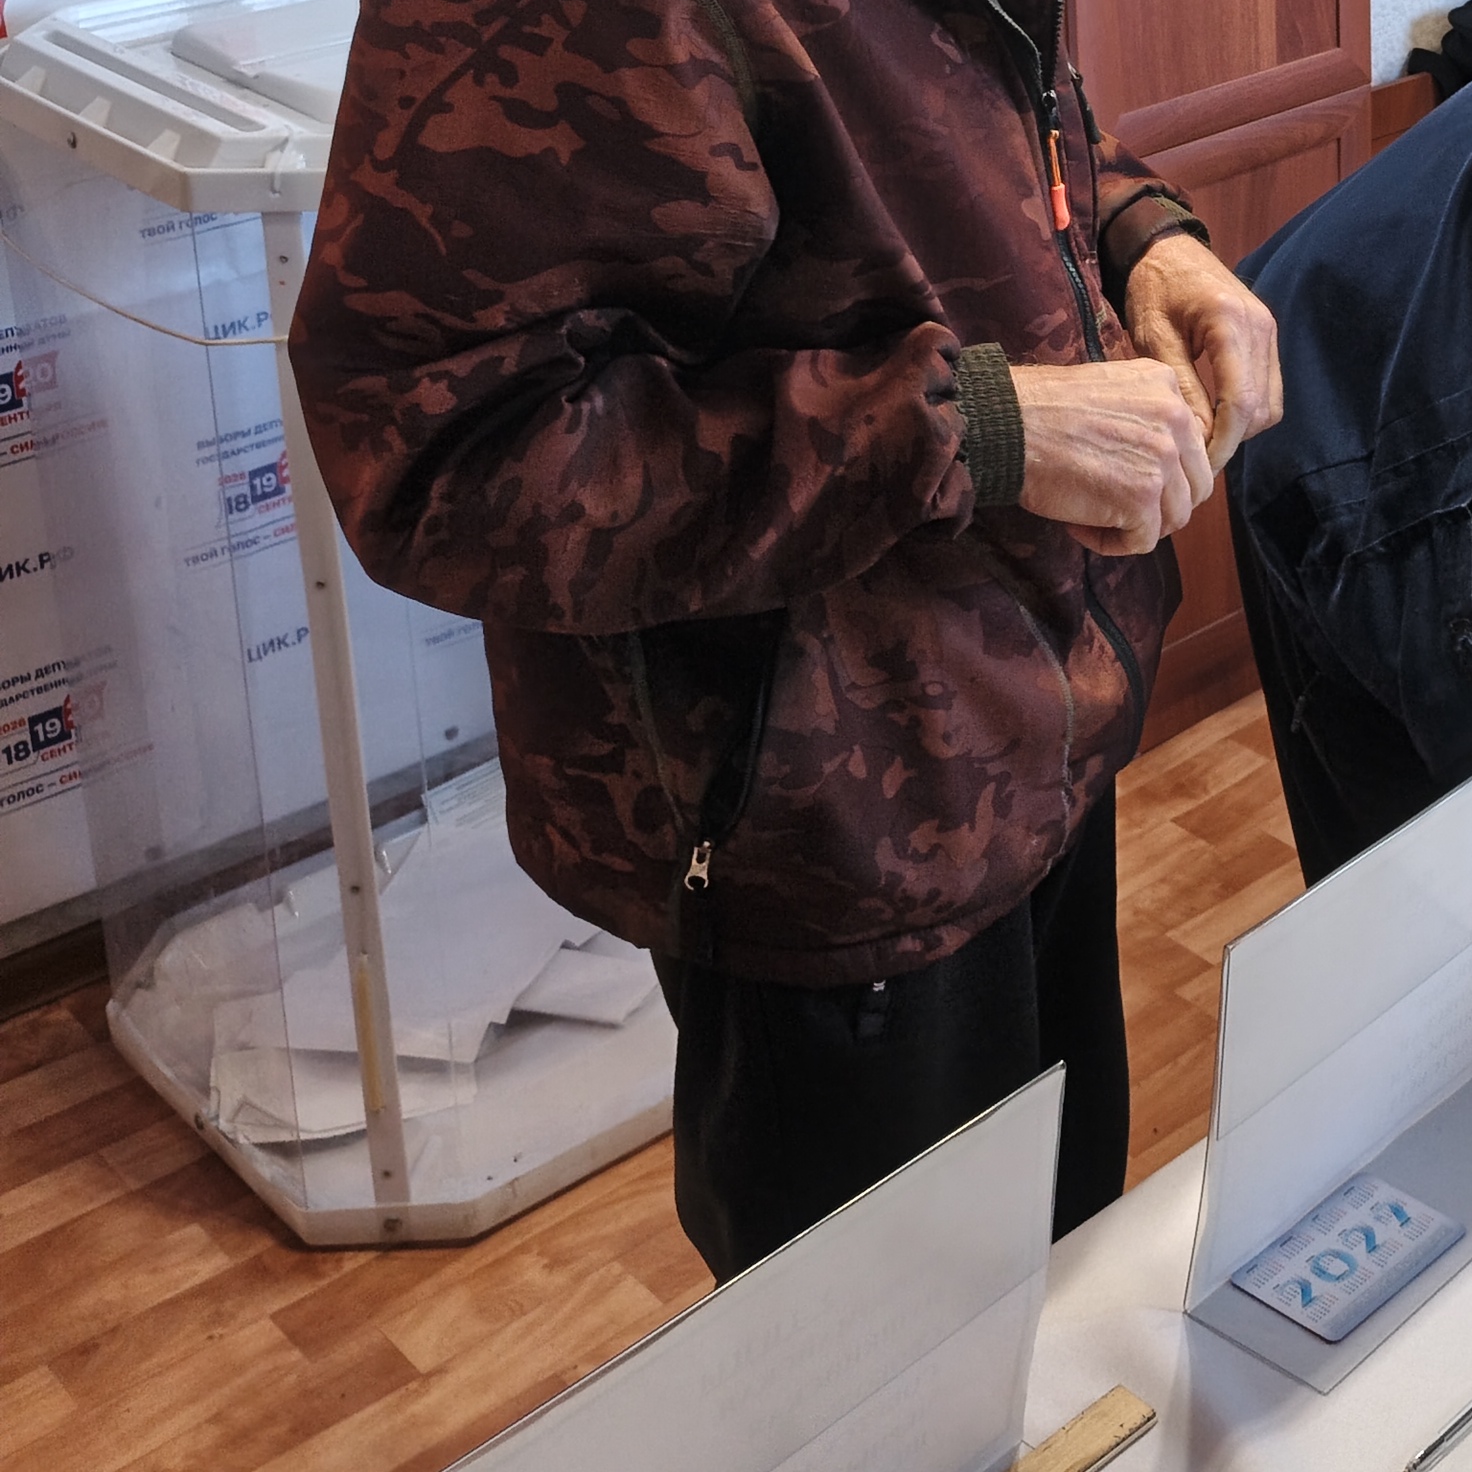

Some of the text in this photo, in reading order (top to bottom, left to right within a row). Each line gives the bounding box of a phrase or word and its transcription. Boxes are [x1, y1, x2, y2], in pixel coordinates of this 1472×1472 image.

[252, 472, 278, 496] 19
[226, 492, 251, 515] 18
[0, 672, 32, 691] ОРЫ
[33, 717, 63, 742] 19
[2, 739, 32, 766] 18
